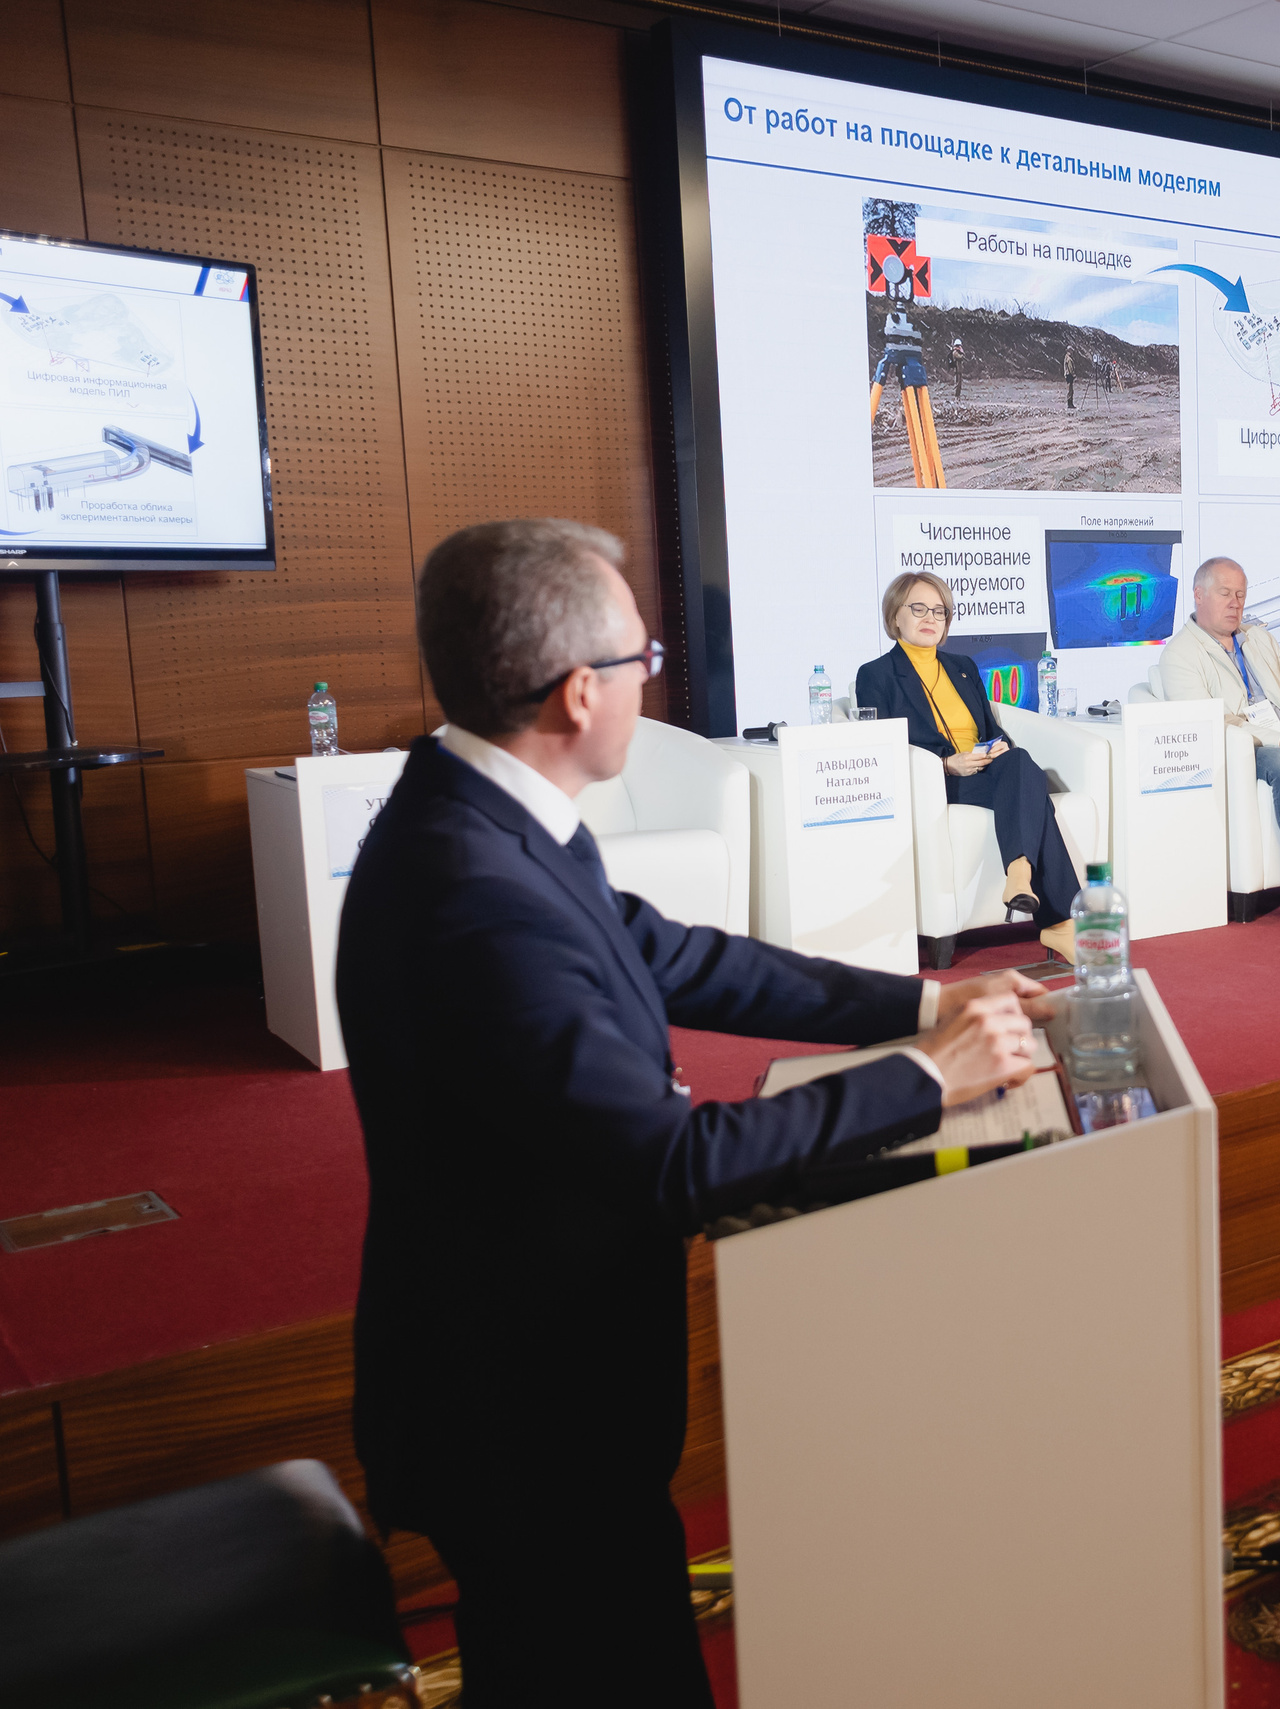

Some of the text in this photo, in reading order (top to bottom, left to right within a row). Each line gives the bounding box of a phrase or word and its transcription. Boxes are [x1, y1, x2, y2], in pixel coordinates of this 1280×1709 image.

[723, 97, 1222, 198] От работ на площадке к детальным моделям
[966, 231, 1132, 270] Работы на площадке
[26, 370, 167, 391] Цифровая информационная
[69, 385, 131, 399] модель ПИЛ
[81, 500, 173, 513] Проработка облика
[60, 513, 193, 525] экспериментальной камеры
[1080, 515, 1154, 528] Поле напряжений
[920, 522, 1011, 541] Численное
[901, 551, 1031, 570] моделирование
[948, 576, 1024, 596] ируемого
[952, 601, 1025, 621] еримента
[1154, 733, 1198, 745] АЛЕКСЕЕВ
[1164, 749, 1189, 760] Игорь
[815, 757, 878, 774] ДАВЫДОВА
[1153, 763, 1200, 775] Евгеньевич
[826, 776, 870, 788] Наталья
[815, 791, 882, 806] Геннадьевна
